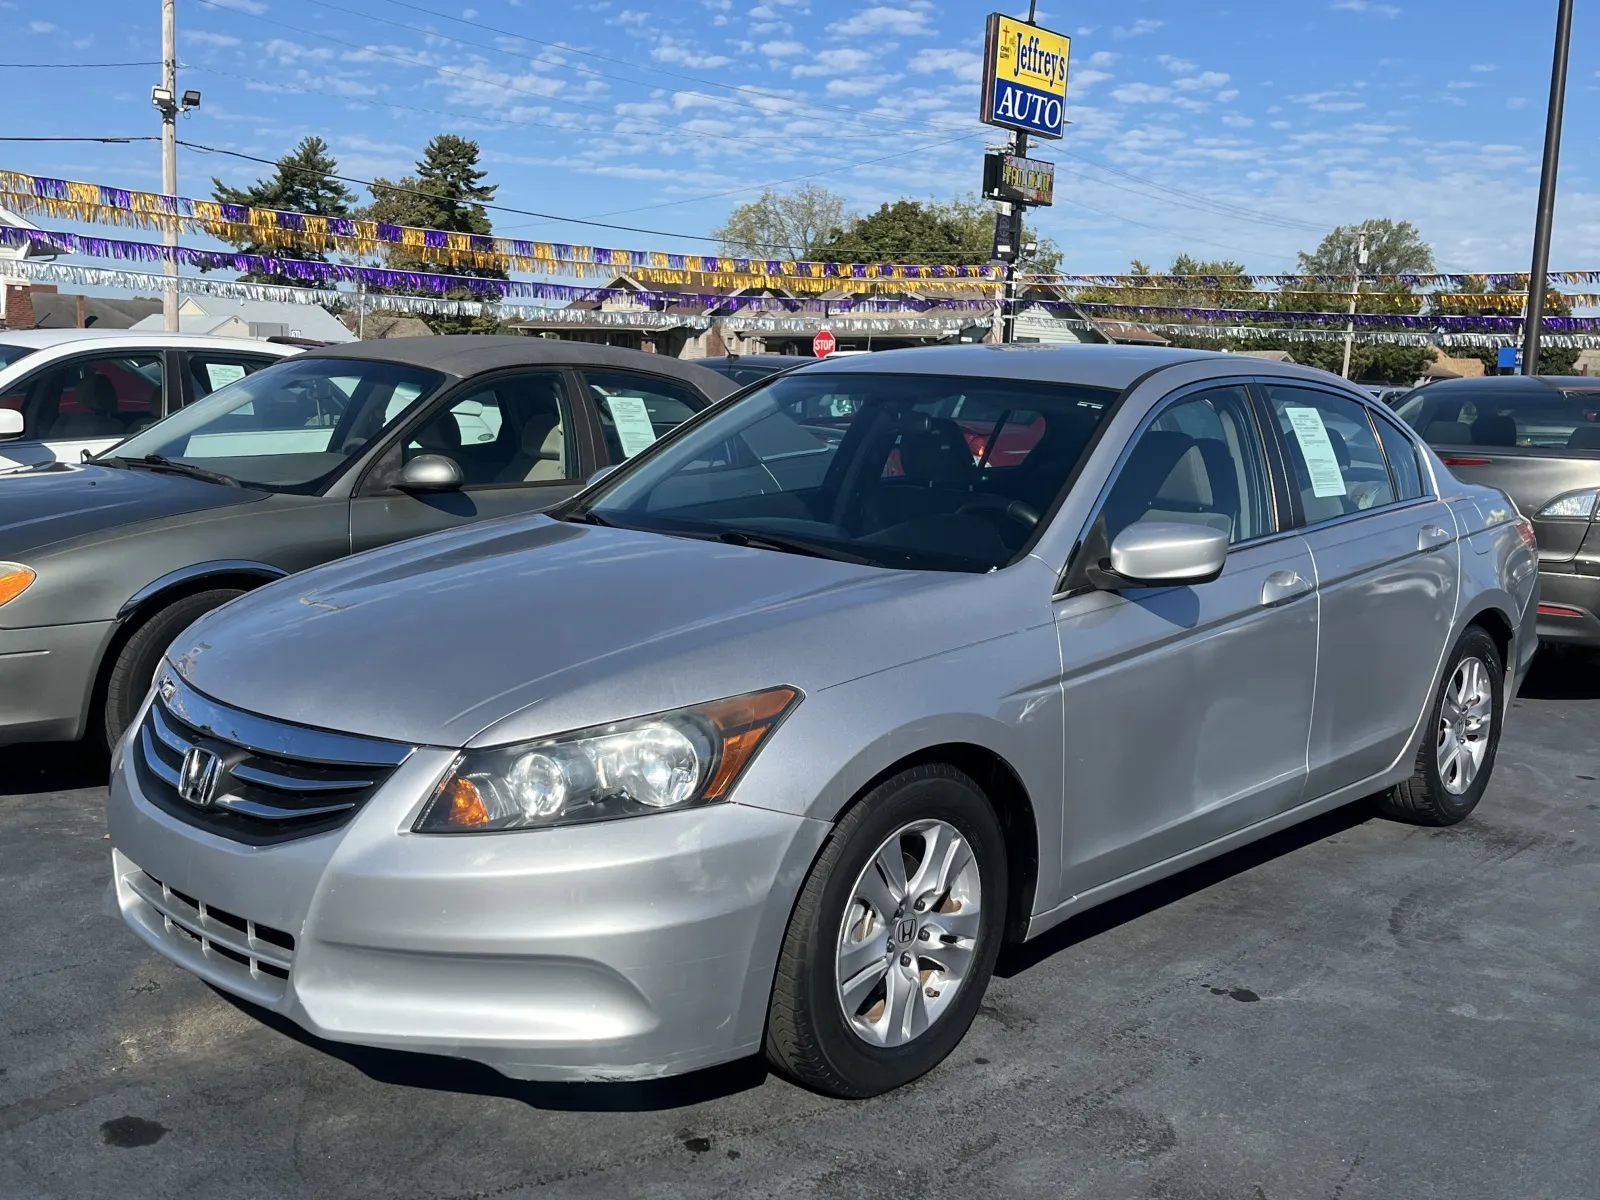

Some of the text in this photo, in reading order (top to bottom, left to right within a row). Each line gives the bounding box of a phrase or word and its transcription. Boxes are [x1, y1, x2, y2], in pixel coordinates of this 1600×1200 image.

[1013, 32, 1065, 87] Jeffrey's
[996, 86, 1062, 128] AUTO
[815, 340, 834, 351] STOP
